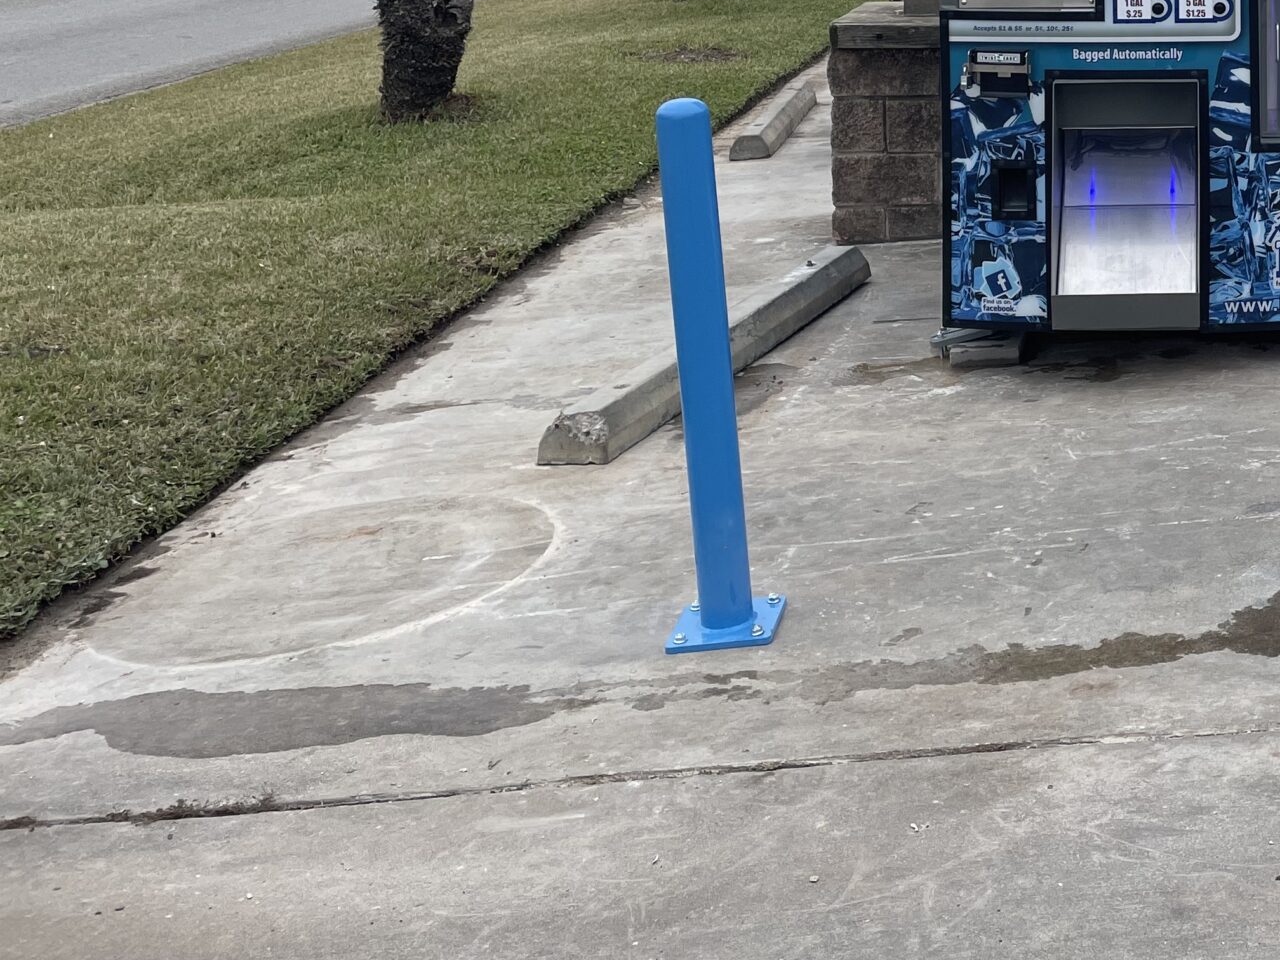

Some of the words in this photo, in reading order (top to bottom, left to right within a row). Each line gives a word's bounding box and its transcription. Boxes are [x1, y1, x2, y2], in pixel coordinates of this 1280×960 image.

[1130, 0, 1144, 7] GAL
[1126, 9, 1143, 18] $.25
[1186, 9, 1206, 18] $1.25
[973, 24, 997, 32] Accepts
[1072, 48, 1111, 62] Bagged
[1112, 48, 1183, 62] Automatically
